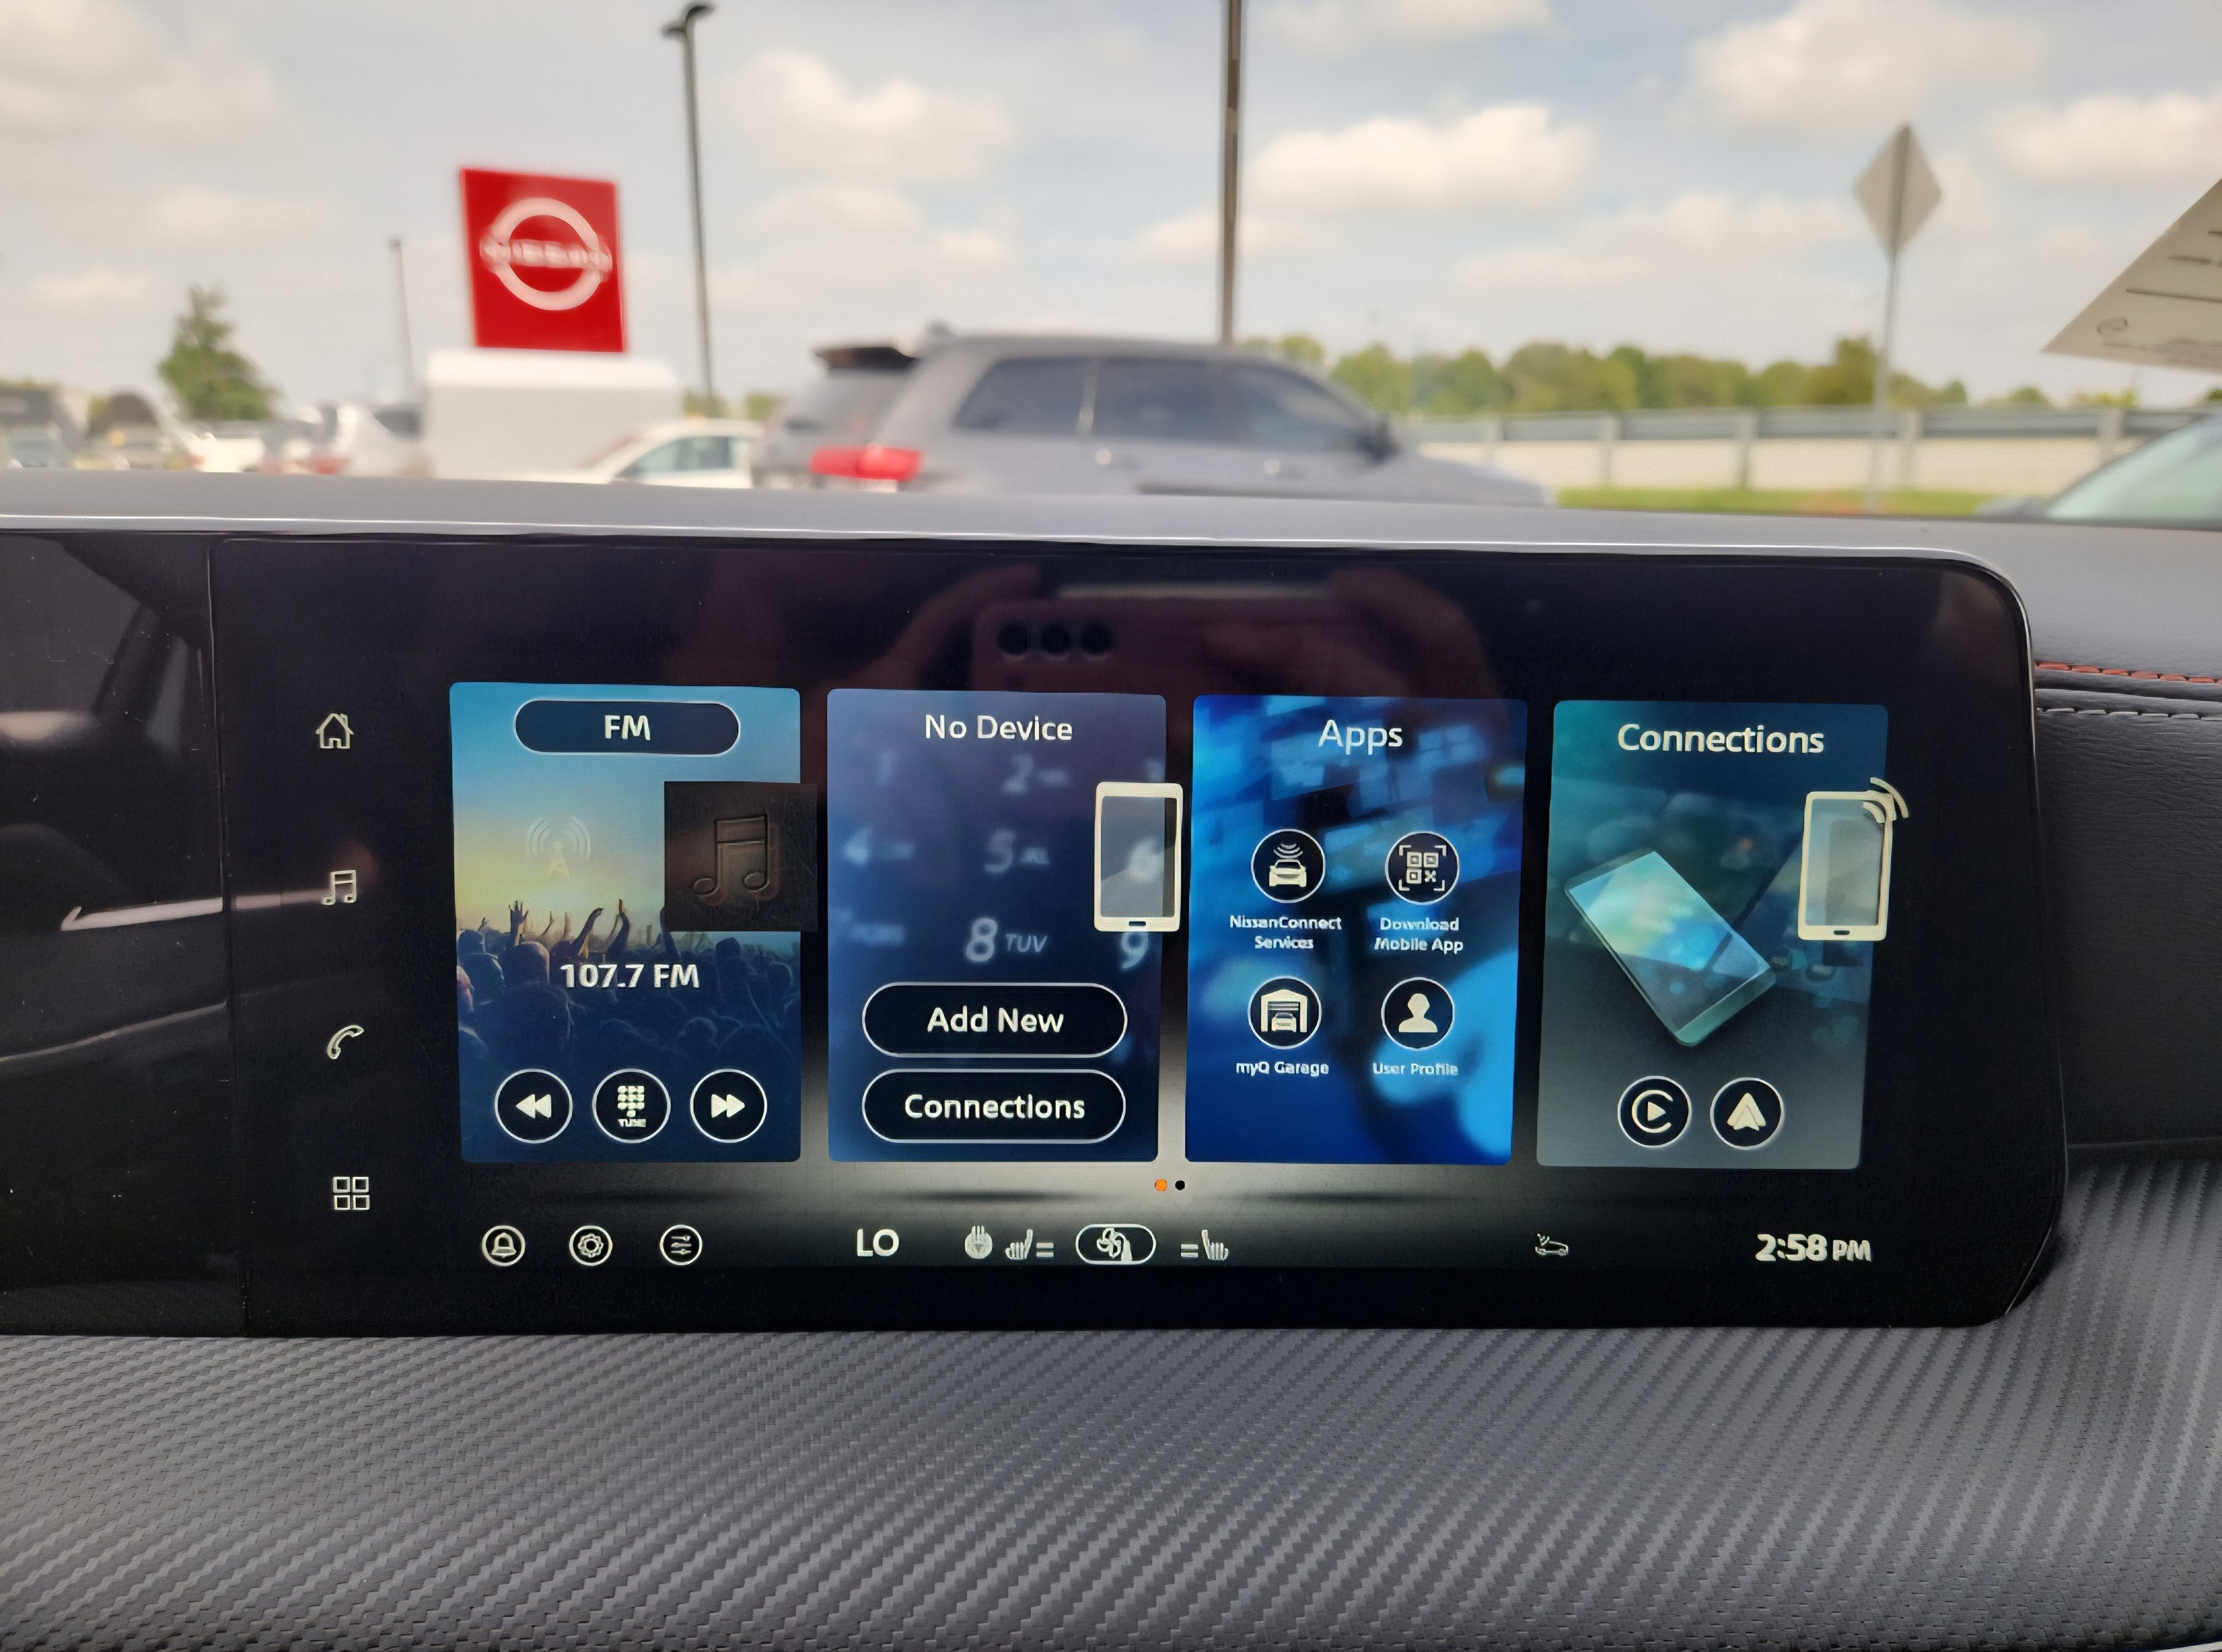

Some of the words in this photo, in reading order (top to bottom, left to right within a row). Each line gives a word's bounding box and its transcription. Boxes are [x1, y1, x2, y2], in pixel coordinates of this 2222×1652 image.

[604, 715, 651, 741] FM
[925, 714, 967, 739] No
[977, 715, 1072, 741] Device
[1318, 719, 1403, 755] Apps
[1618, 724, 1824, 753] Connections
[1230, 915, 1342, 930] NissanConnect
[1380, 917, 1459, 931] Download
[965, 917, 997, 963] 8
[1006, 933, 1048, 954] TUV
[1121, 930, 1149, 971] 9
[1255, 936, 1314, 949] Services
[1374, 937, 1428, 950] Mobile
[1431, 938, 1463, 955] App
[560, 963, 644, 988] 107.7
[654, 964, 700, 988] FM
[927, 1005, 988, 1032] Add
[998, 1008, 1064, 1033] New
[1236, 1061, 1270, 1076] myQ
[1274, 1061, 1329, 1077] Garage
[1372, 1062, 1406, 1074] User
[1410, 1063, 1458, 1075] Profile
[905, 1094, 1085, 1119] Connections
[856, 1228, 899, 1257] LO
[1755, 1233, 1827, 1262] 2:58
[1832, 1240, 1871, 1262] PM
